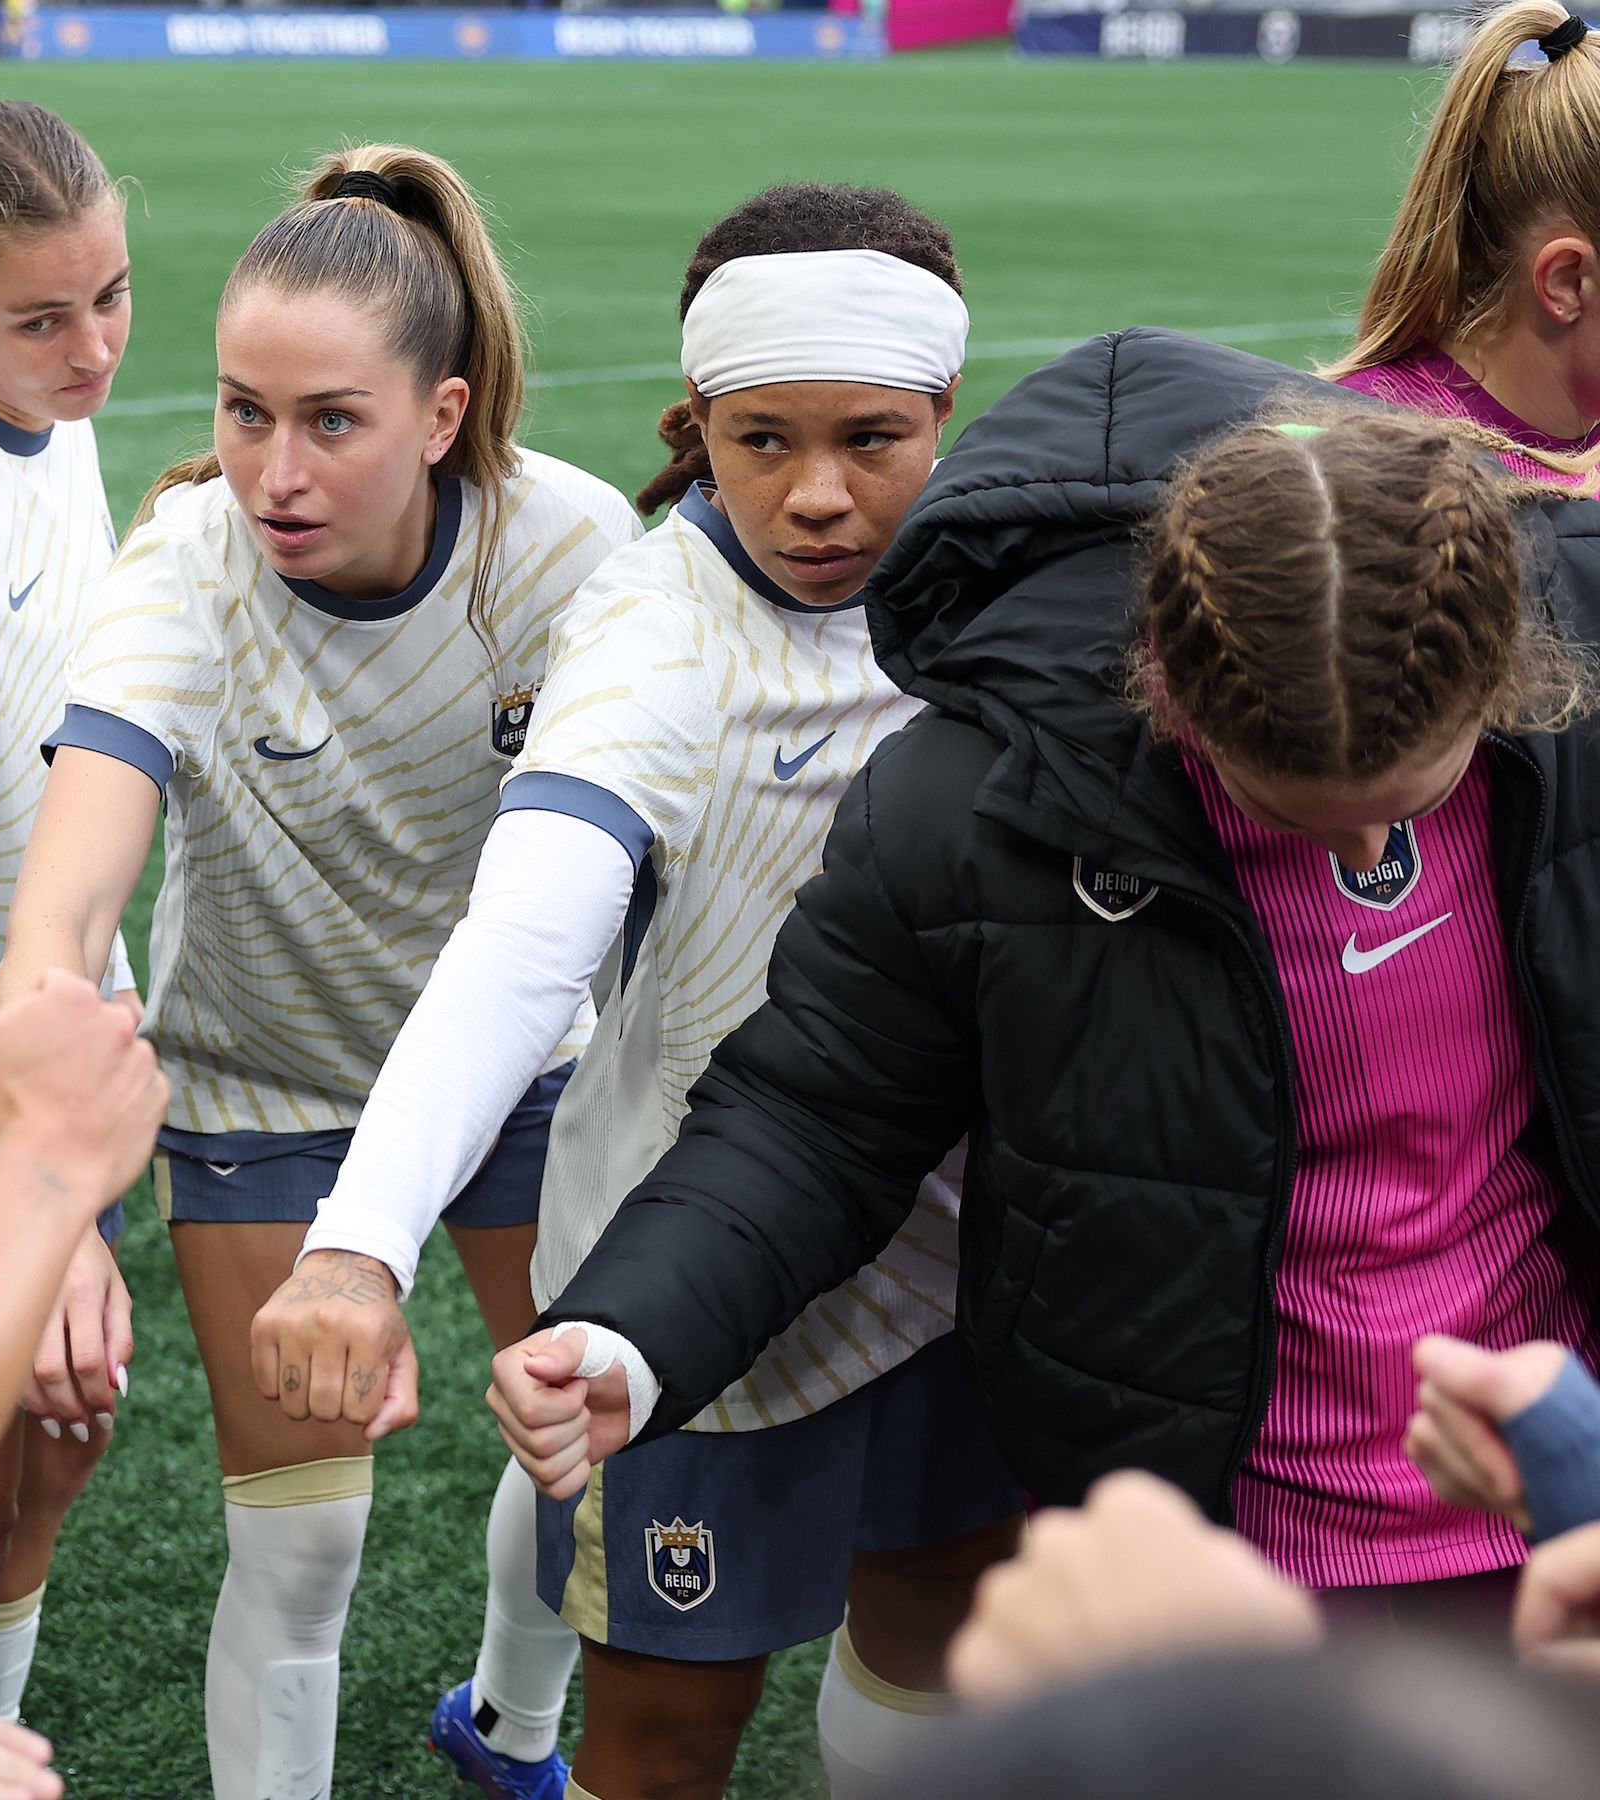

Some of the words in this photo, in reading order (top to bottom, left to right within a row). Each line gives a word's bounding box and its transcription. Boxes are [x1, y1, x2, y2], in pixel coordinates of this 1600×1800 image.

[501, 728, 526, 748] REIG
[1094, 871, 1140, 895] REIGN
[1356, 860, 1405, 889] REIGN
[1375, 883, 1392, 896] FC
[664, 1573, 701, 1591] REIGN
[677, 1590, 690, 1598] FC
